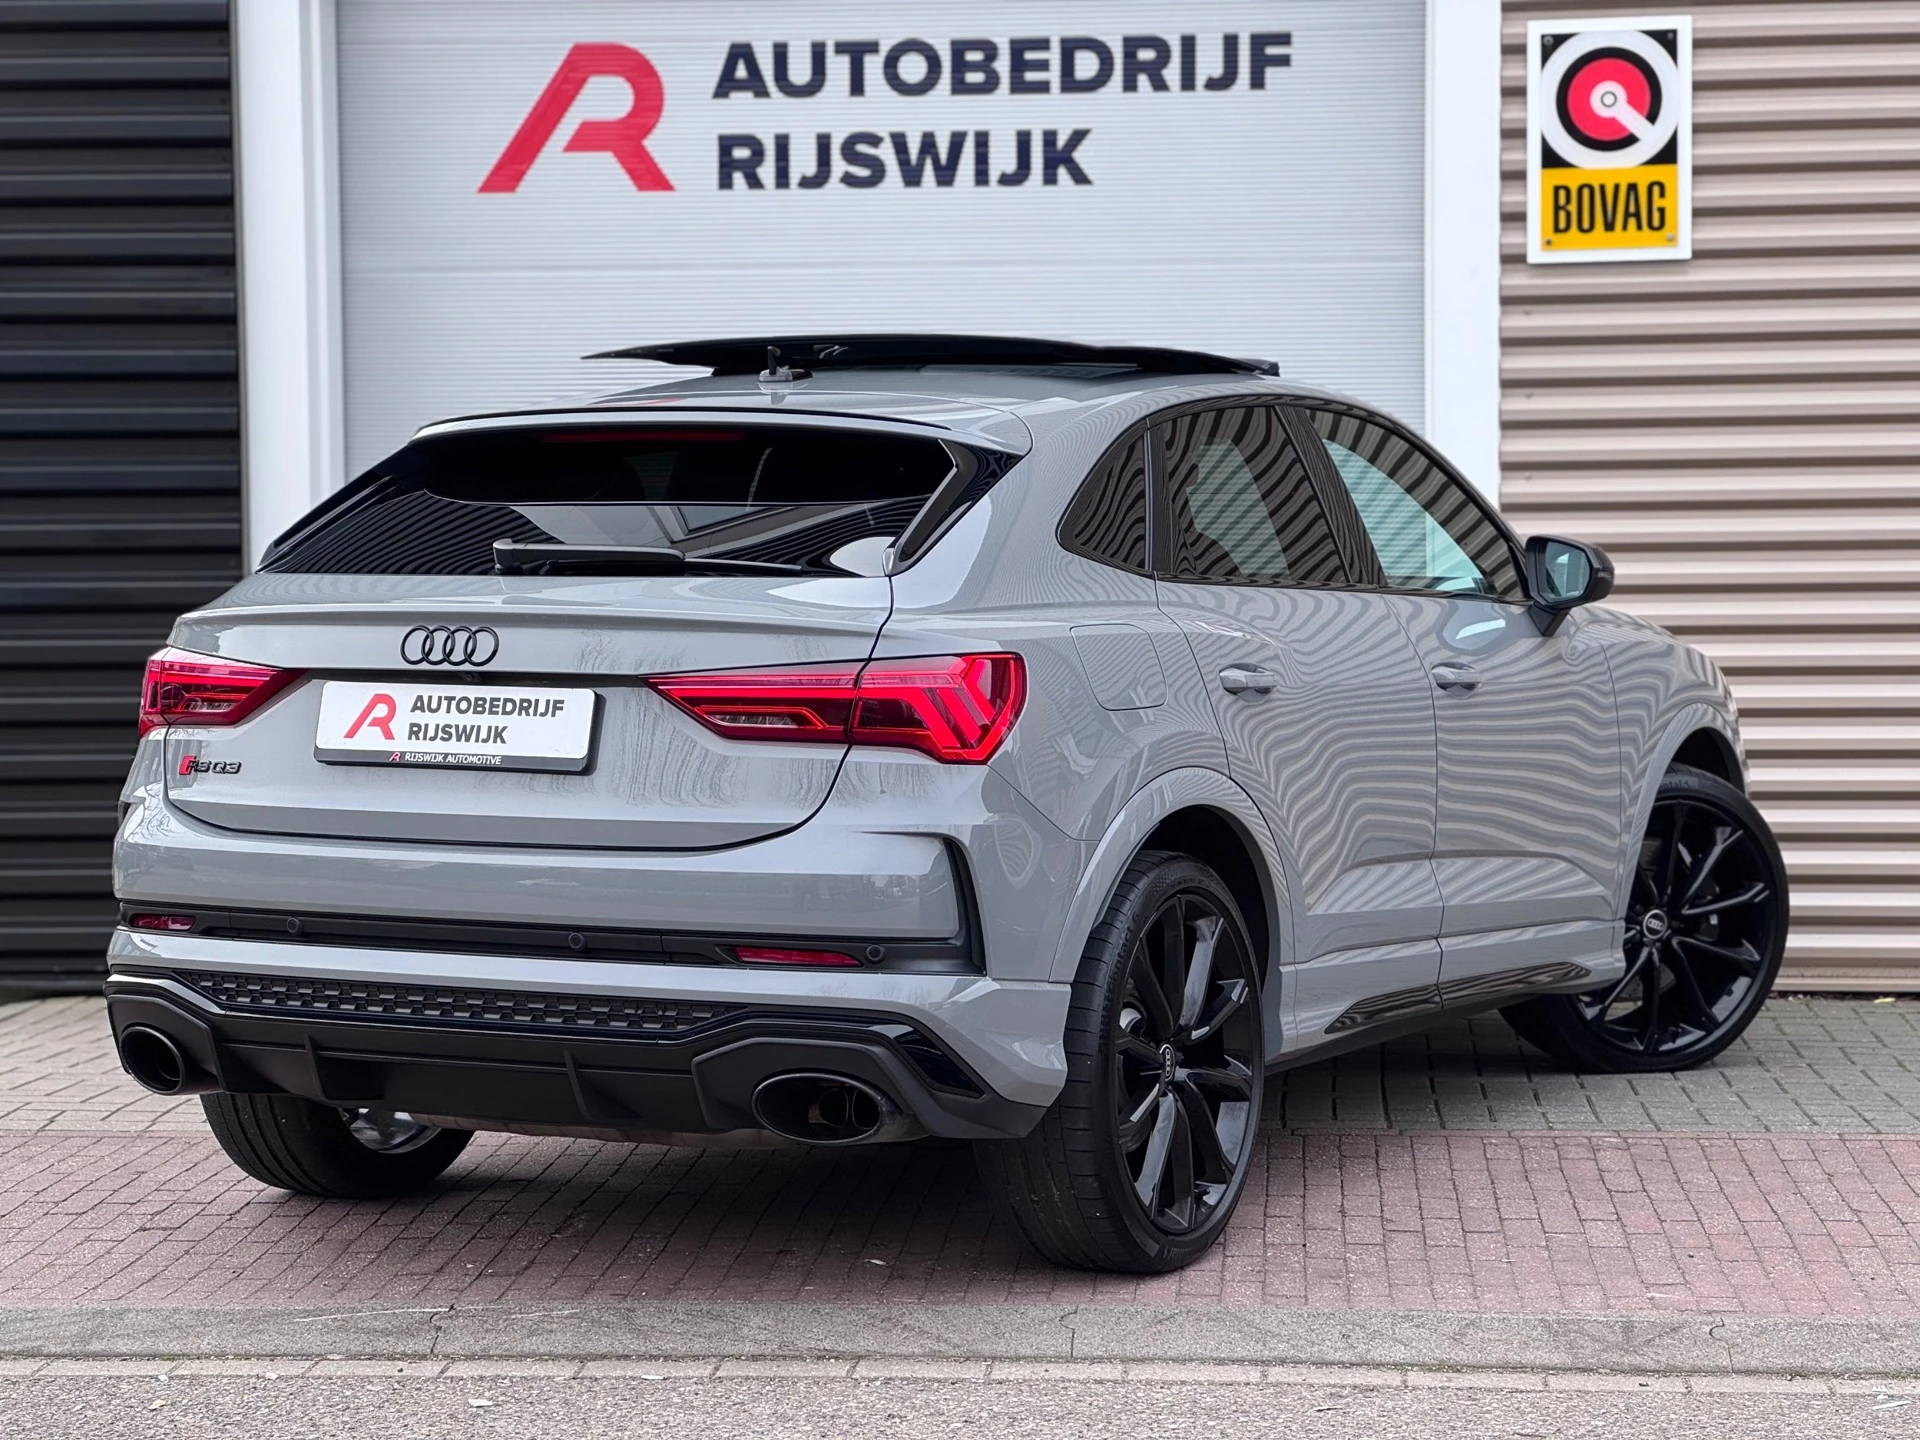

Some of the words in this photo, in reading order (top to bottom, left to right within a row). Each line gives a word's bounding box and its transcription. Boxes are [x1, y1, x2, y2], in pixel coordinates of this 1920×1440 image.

[712, 32, 1293, 100] AUTOBEDRIJF
[717, 129, 1093, 191] RIJSWIJK
[1553, 181, 1666, 234] BOVAG
[410, 694, 565, 718] AUTOBEDRIJF
[407, 722, 509, 745] RIJSWIJK
[405, 752, 445, 763] RIJSWIJK
[446, 754, 503, 765] AUTOMOTIVE
